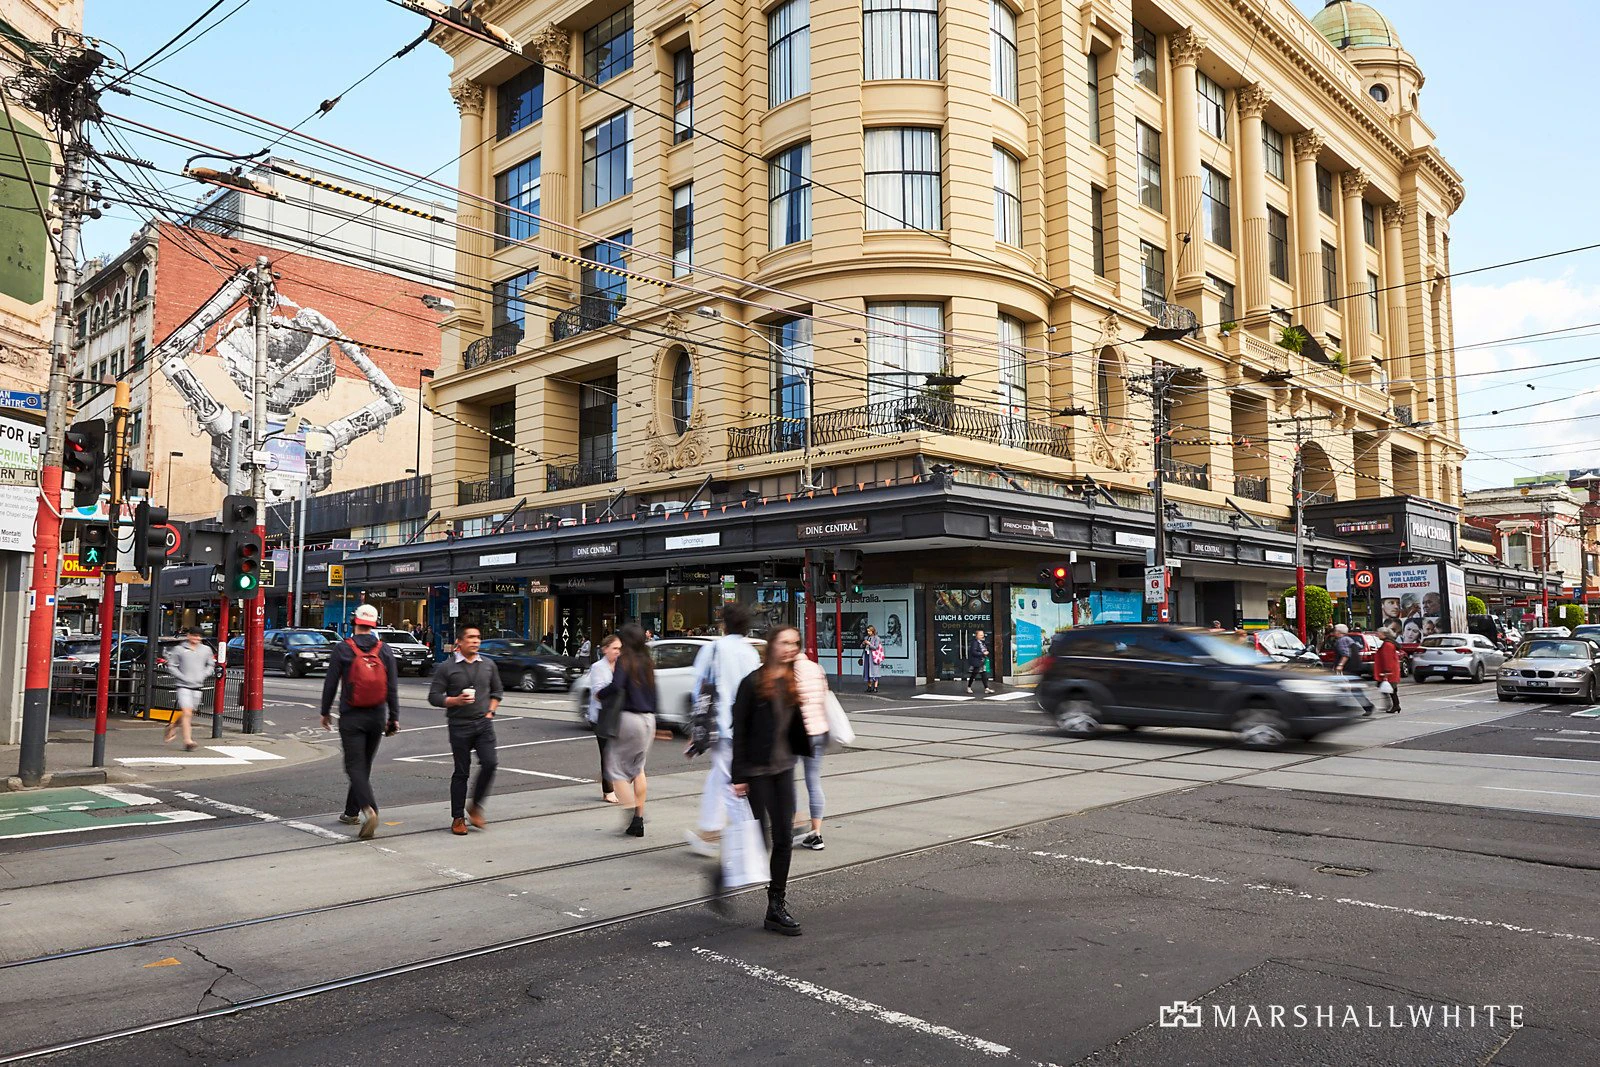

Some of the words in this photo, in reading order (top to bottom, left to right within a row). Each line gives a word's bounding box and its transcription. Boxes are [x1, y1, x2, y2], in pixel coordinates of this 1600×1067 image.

[0, 424, 24, 442] FOR
[805, 525, 823, 535] DINE
[825, 522, 858, 533] CENTRAL
[1428, 525, 1452, 543] CENTRAL
[577, 547, 589, 556] DINE
[590, 545, 612, 554] CENTRAL
[1194, 543, 1204, 551] DINE
[1204, 545, 1220, 553] CENTRAL
[568, 579, 586, 588] KAYA
[1358, 575, 1371, 583] 40
[495, 584, 516, 593] KAYA
[562, 617, 570, 657] KAYA
